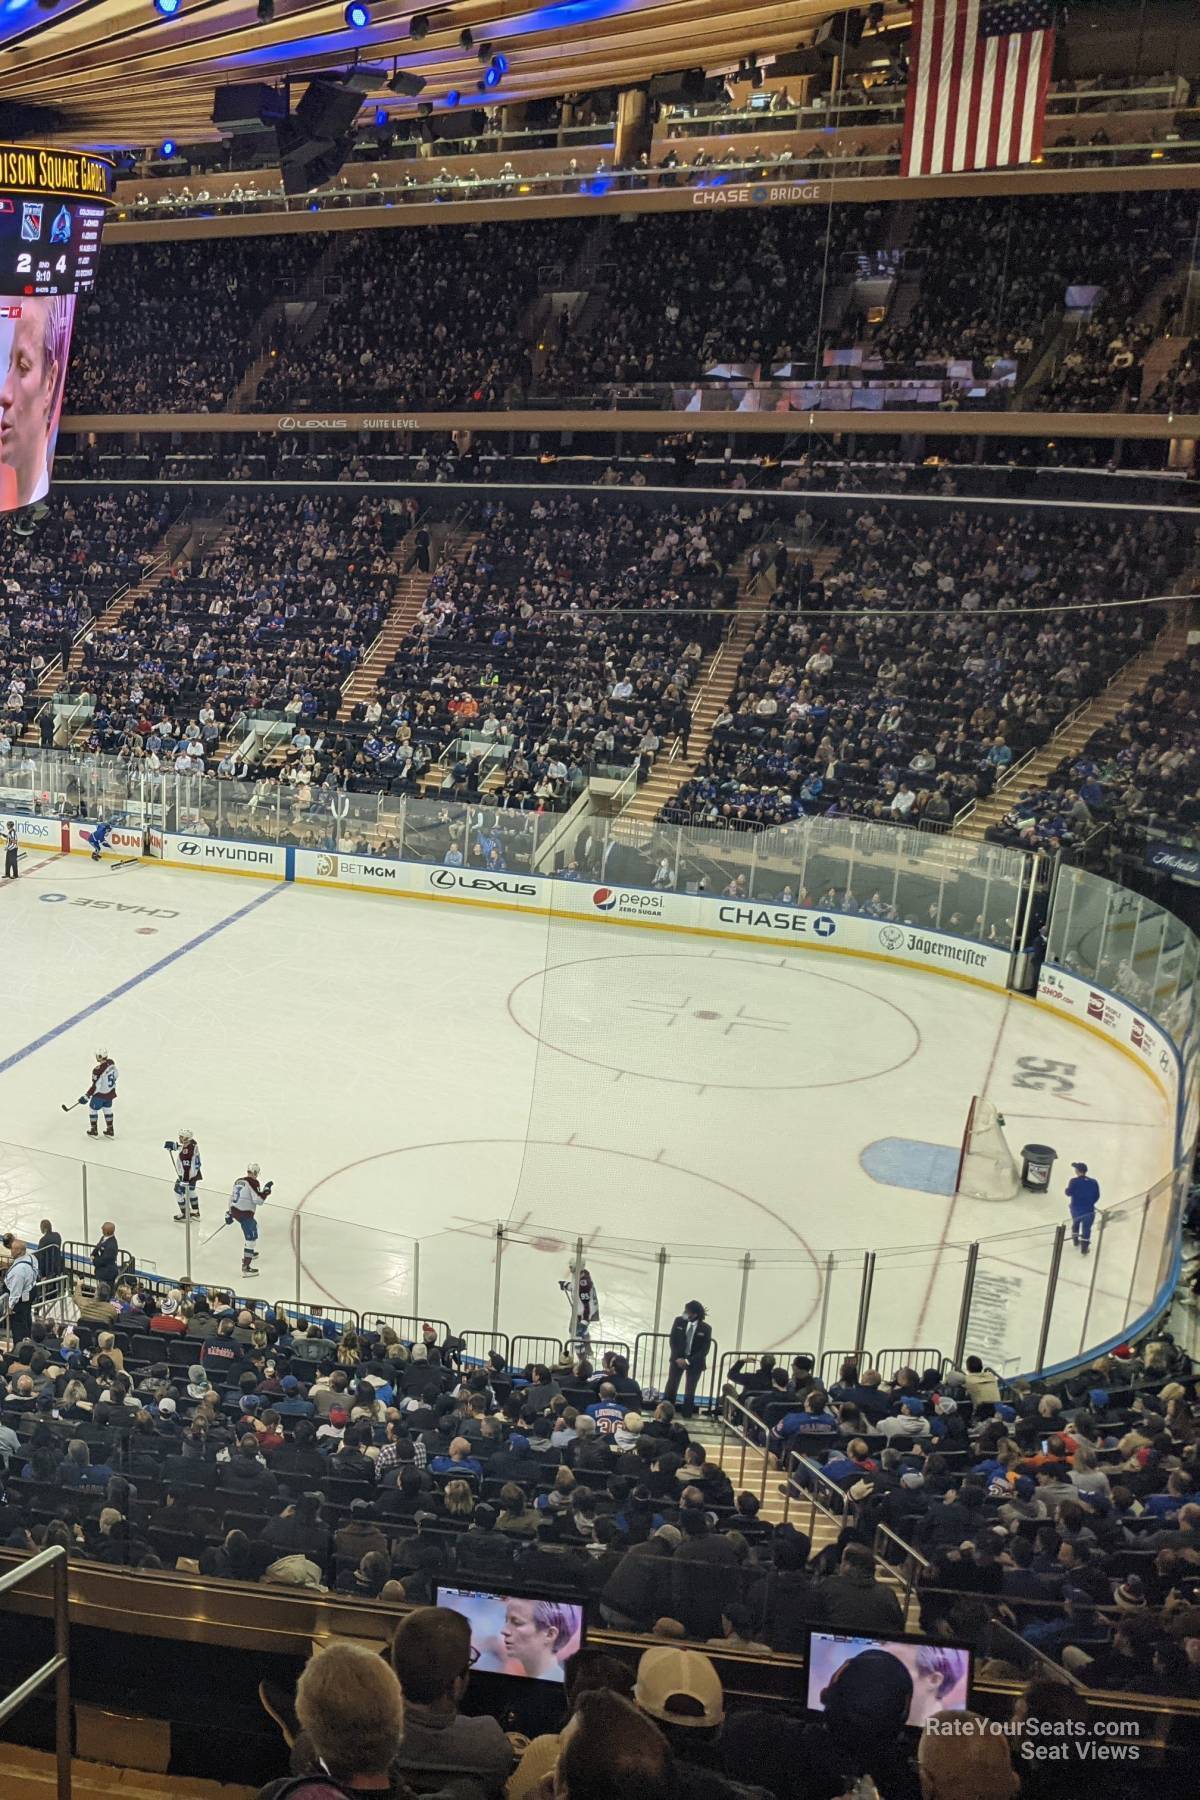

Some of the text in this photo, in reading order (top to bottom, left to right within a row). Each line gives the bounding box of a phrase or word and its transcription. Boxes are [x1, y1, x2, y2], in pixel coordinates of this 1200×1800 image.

[39, 152, 80, 190] SQUARE
[81, 160, 107, 193] GARDEN
[692, 184, 821, 206] CHASE BRIDGE
[16, 253, 32, 272] 2
[56, 254, 66, 274] 4
[36, 270, 51, 282] 9:10
[296, 419, 348, 429] LEXUS
[362, 418, 420, 430] SUITE LEVEL
[15, 820, 48, 837] Infosys
[206, 846, 273, 864] HYUNDAI
[340, 862, 396, 878] BETMGM
[458, 878, 536, 896] LEXUS
[68, 896, 180, 919] CHASE
[618, 892, 664, 908] pepsi
[618, 906, 662, 916] ZERO SUGAR
[719, 906, 808, 932] CHASE
